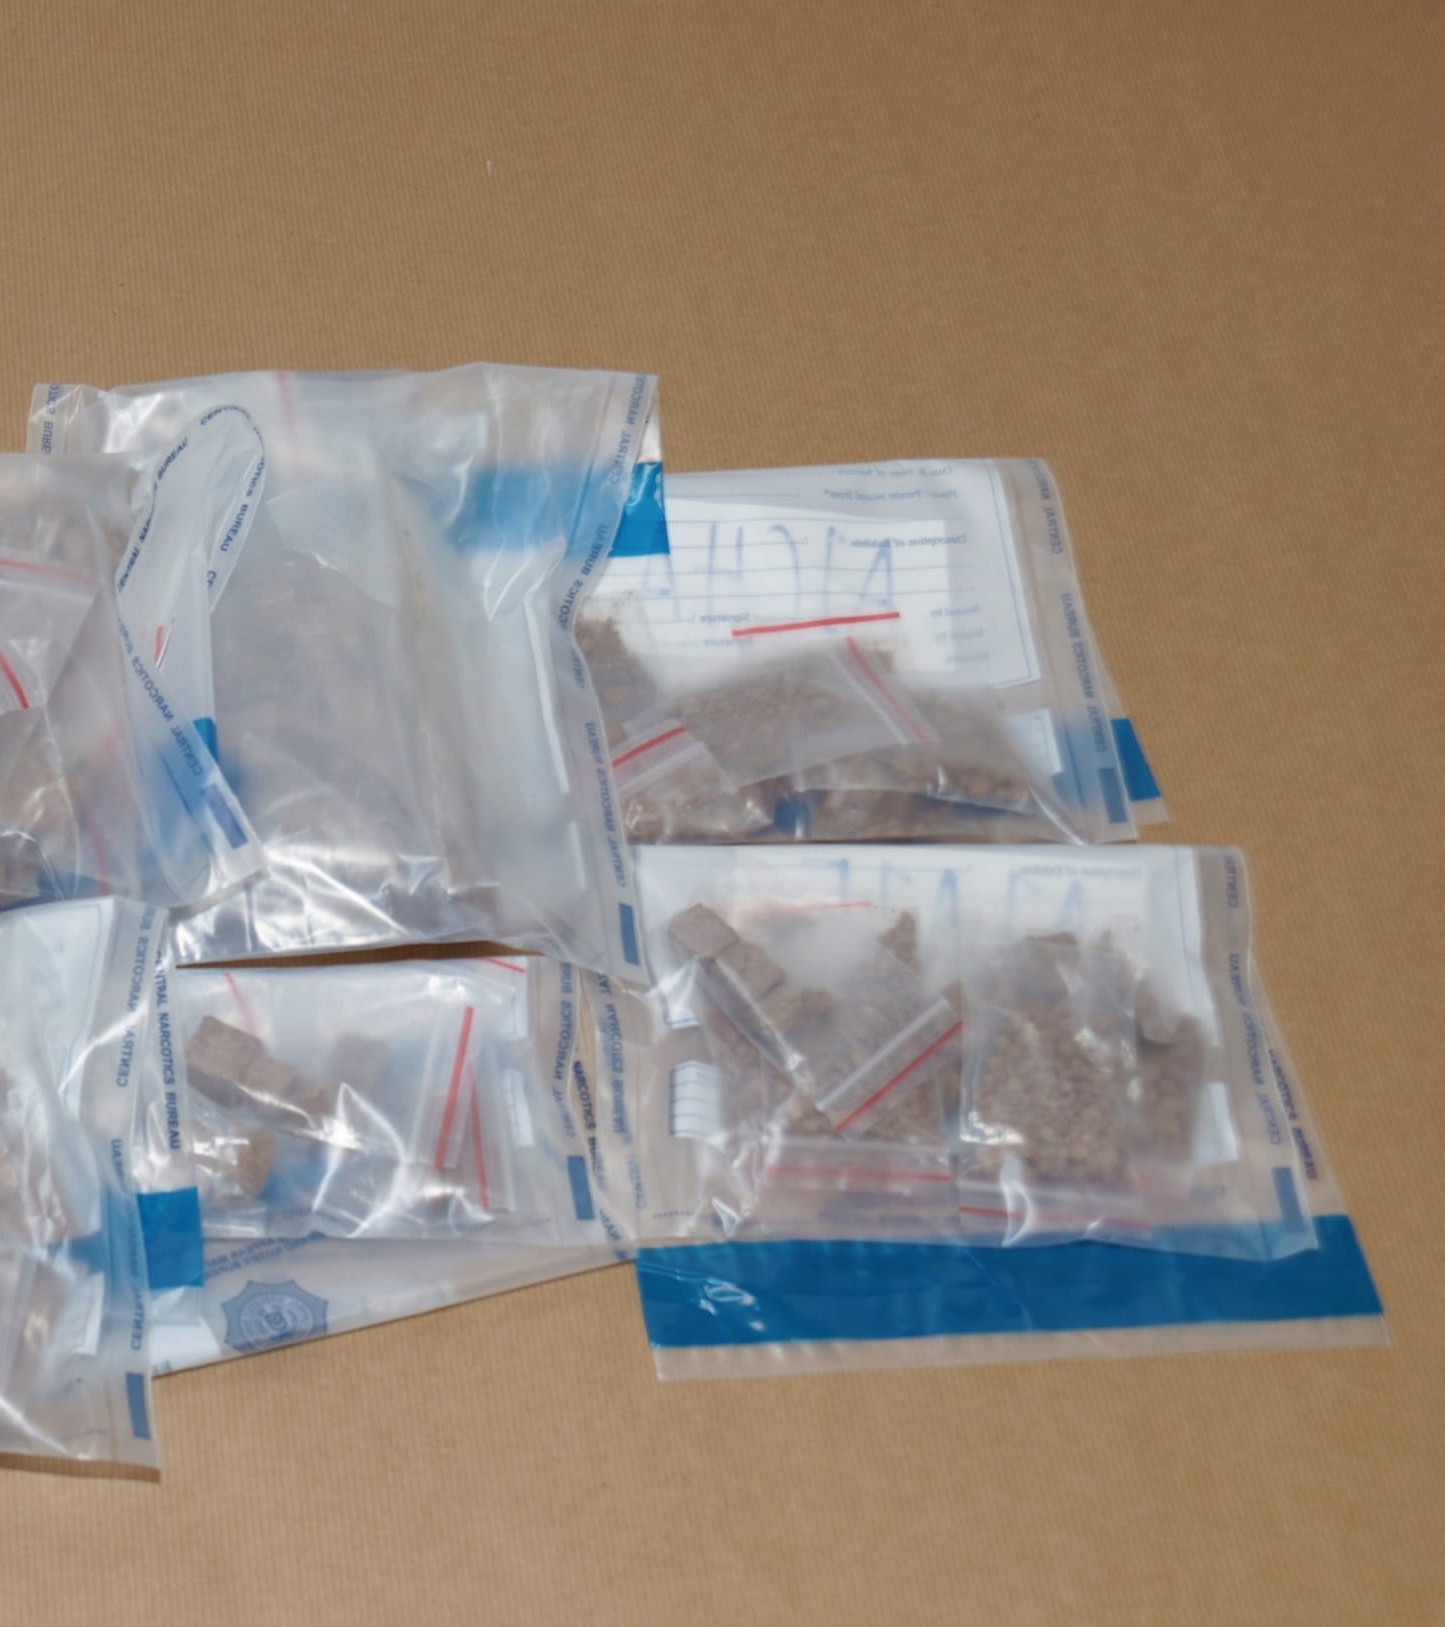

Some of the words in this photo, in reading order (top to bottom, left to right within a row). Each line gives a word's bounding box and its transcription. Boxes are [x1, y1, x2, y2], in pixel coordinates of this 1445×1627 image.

[219, 503, 249, 552] BUREAU
[158, 1012, 175, 1086] NARCOTICS
[165, 1091, 182, 1150] BUREAU
[572, 1060, 597, 1132] NARCOTICS
